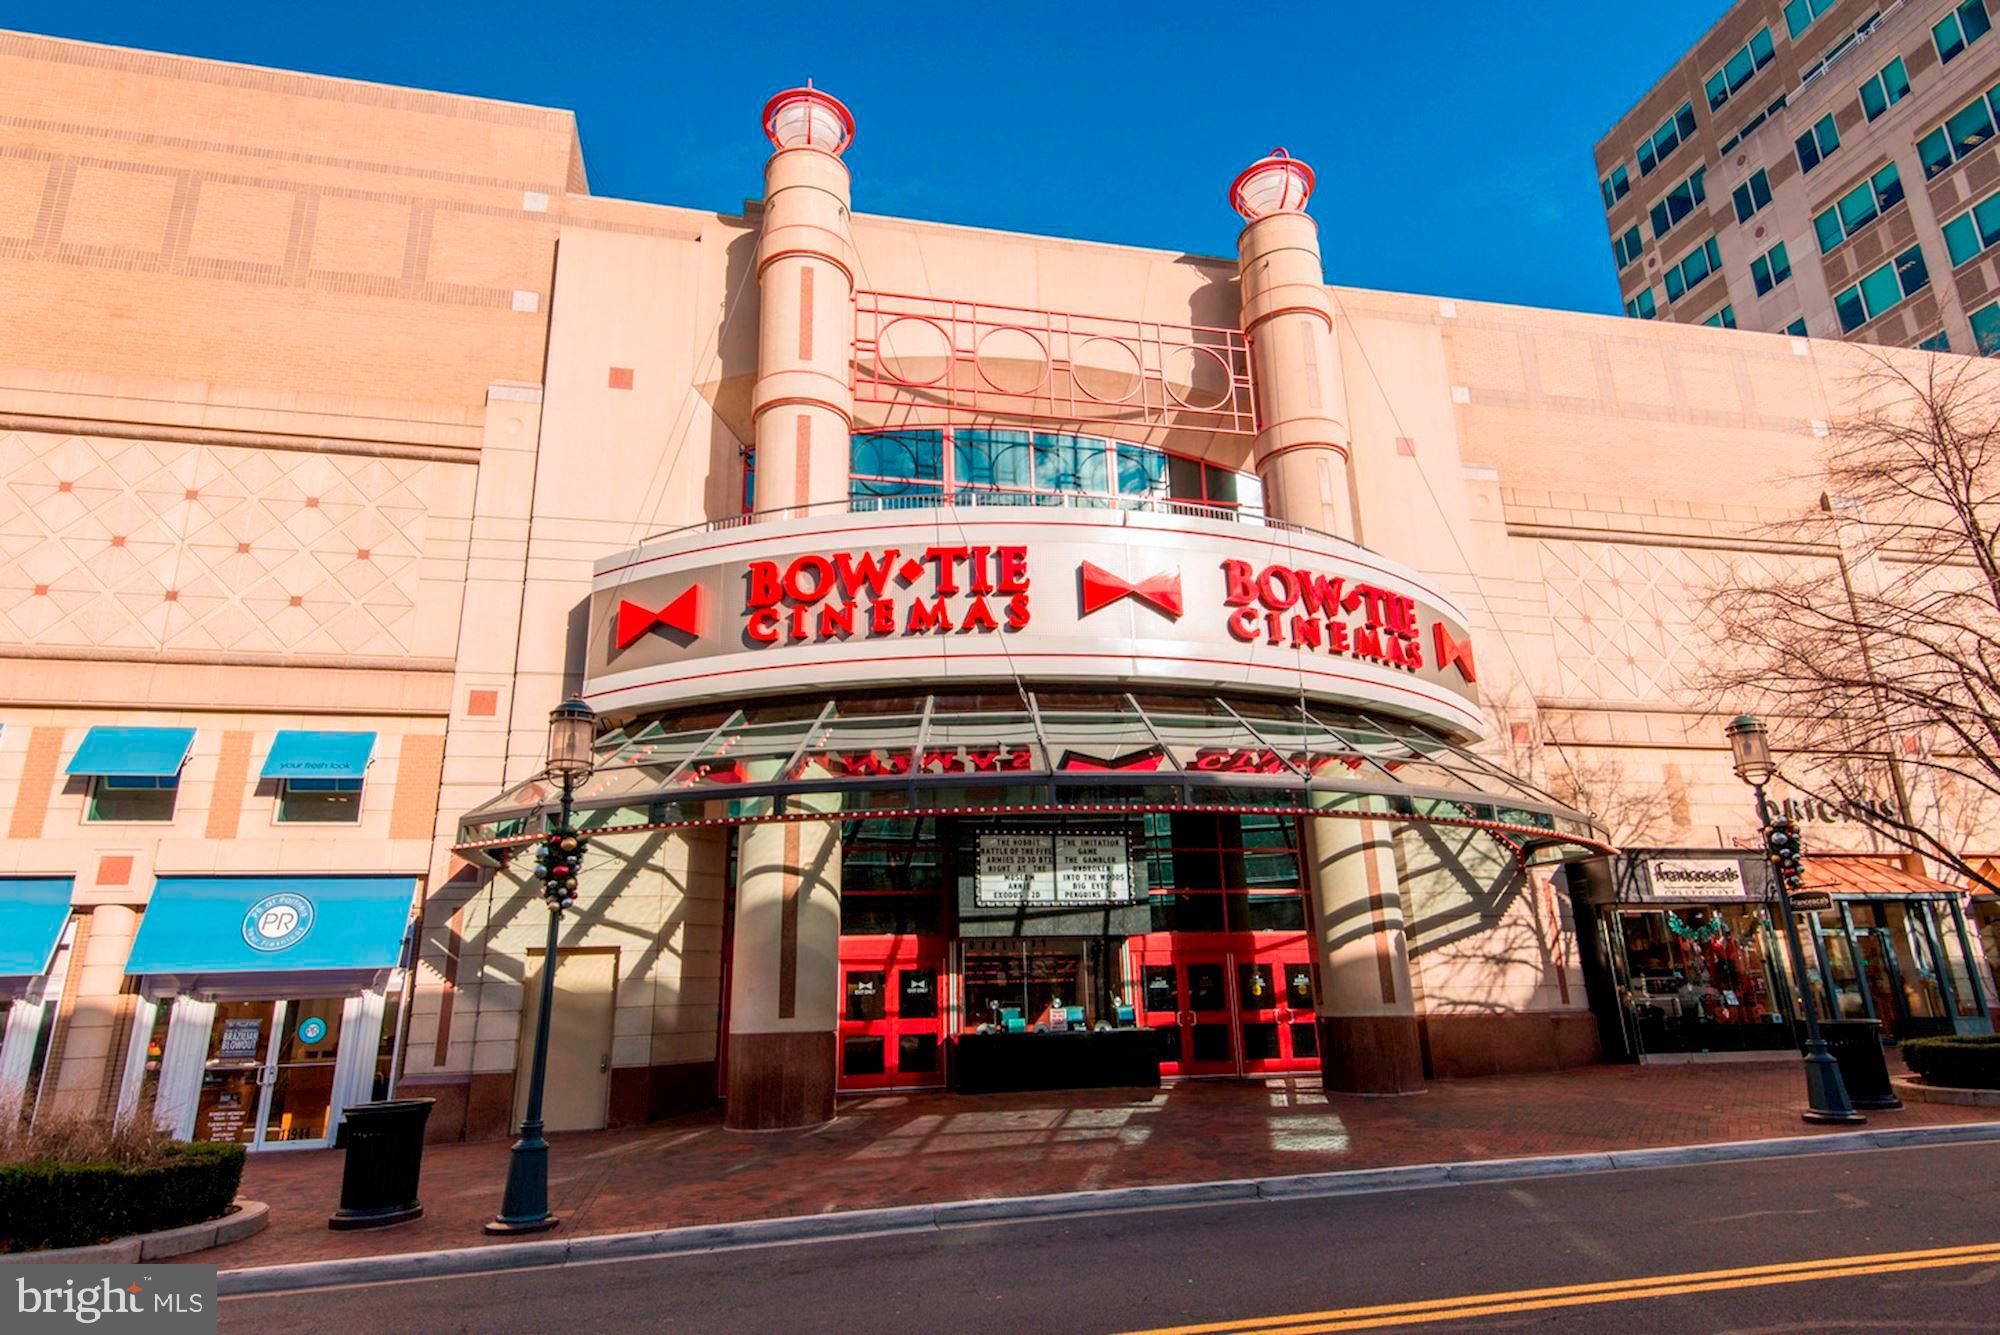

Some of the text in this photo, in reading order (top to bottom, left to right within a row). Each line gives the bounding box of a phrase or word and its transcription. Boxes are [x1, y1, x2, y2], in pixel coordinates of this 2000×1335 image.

[747, 593, 1031, 641] CINEMAS
[1227, 606, 1424, 673] CINEMAS
[280, 761, 352, 770] your fresh look
[997, 839, 1040, 847] THE HOBBIT
[1063, 839, 1119, 847] THE IMITATION
[981, 847, 1008, 855] BATTLE
[1010, 847, 1019, 855] OF
[1021, 847, 1034, 855] THE
[1077, 847, 1097, 855] GAME
[987, 856, 1014, 864] ARMIES
[1065, 856, 1116, 864] THE GAMBLER
[988, 865, 1046, 873] NIGHT AT THE
[1654, 862, 1739, 882] francesca's
[1063, 873, 1125, 881] INTO THE WOODS
[1009, 882, 1030, 890] ANNIE
[1073, 882, 1109, 890] BIG EYES
[993, 891, 1041, 899] EXODUS 2D
[261, 912, 294, 931] PR
